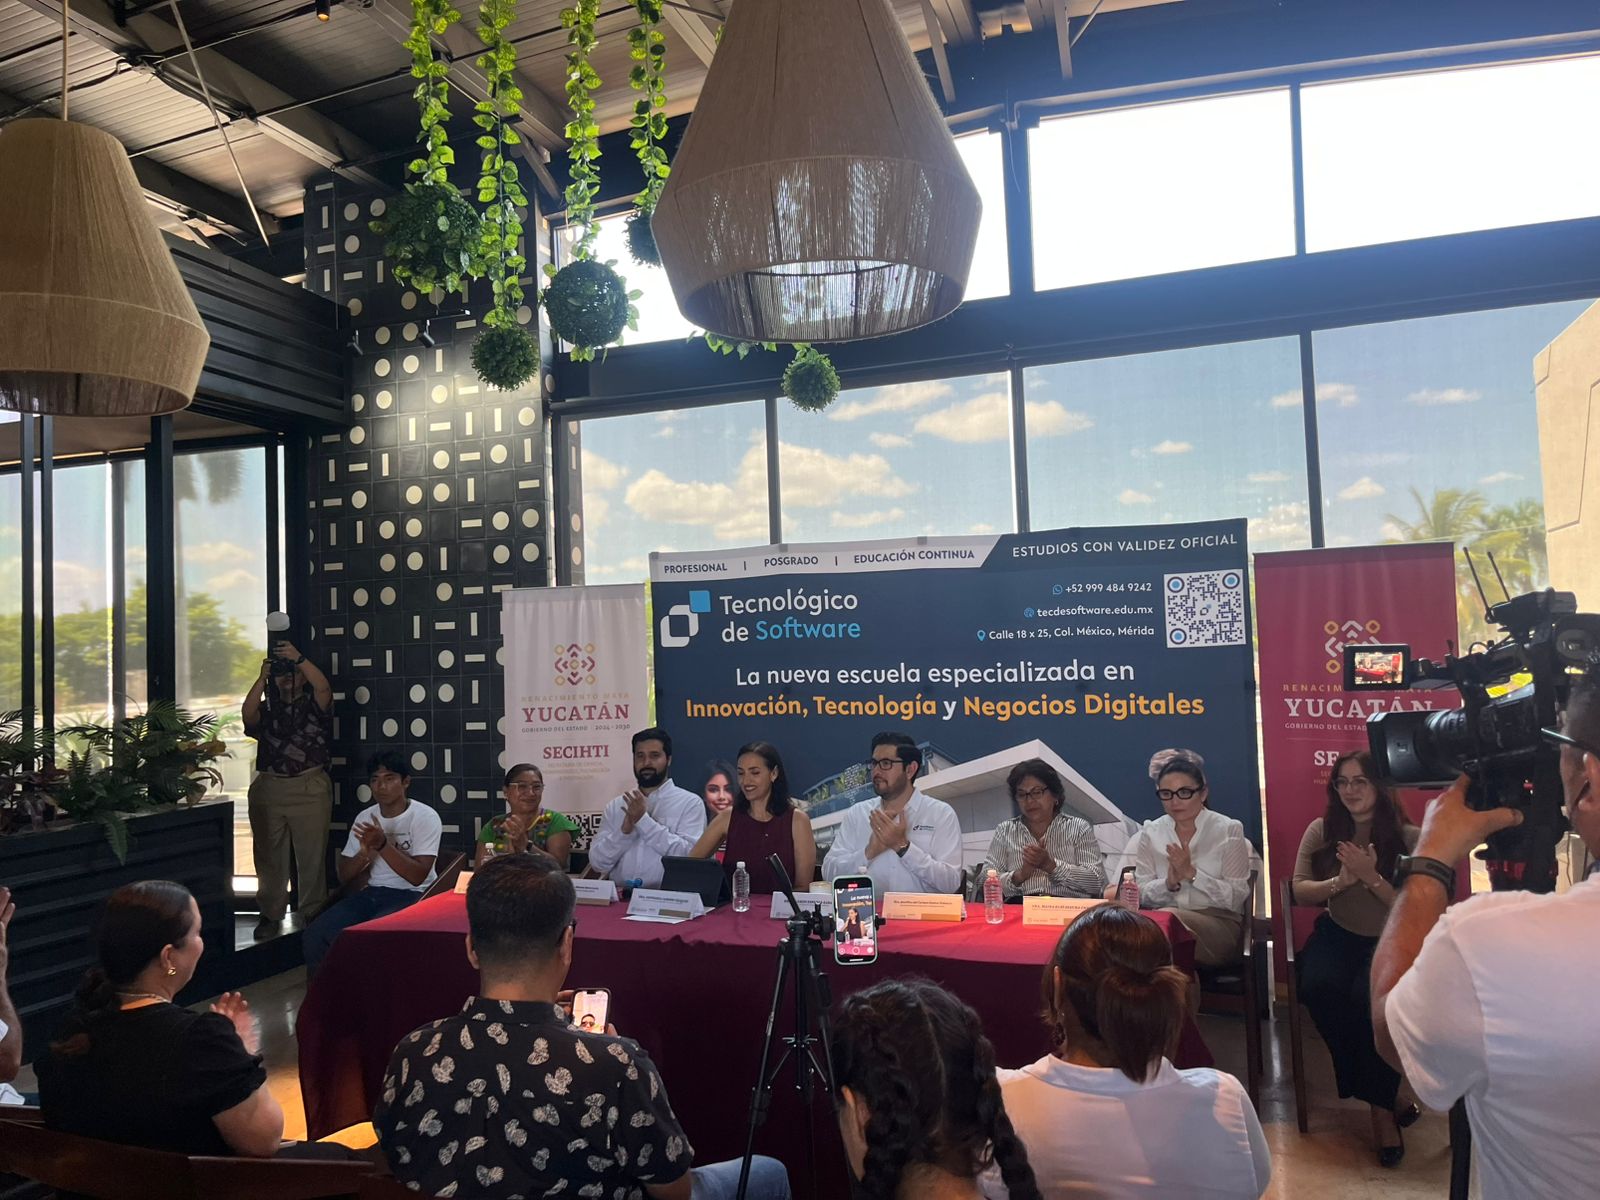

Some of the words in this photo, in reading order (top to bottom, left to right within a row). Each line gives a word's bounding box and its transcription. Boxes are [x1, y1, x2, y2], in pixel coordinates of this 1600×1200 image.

[1012, 542, 1078, 557] ESTUDIOS
[1083, 541, 1113, 552] CON
[1117, 538, 1176, 551] VALIDEZ
[1180, 533, 1237, 549] OFICIAL
[664, 563, 727, 574] PROFESIONAL
[764, 556, 819, 567] POSGRADO
[854, 548, 916, 564] EDUCACIÓN
[918, 549, 975, 560] CONTINUA
[1065, 584, 1083, 593] +52
[1085, 584, 1103, 592] 999
[1106, 583, 1125, 592] 484
[1127, 583, 1152, 592] 9242
[719, 588, 858, 615] Tecnológico
[1037, 605, 1153, 617] tecdesoftware.edu.mx
[721, 621, 749, 642] de
[756, 617, 861, 640] Software
[989, 630, 1014, 640] Calle
[1016, 630, 1027, 639] 18
[1037, 629, 1052, 639] 25,
[1054, 628, 1074, 637] Col.
[1076, 627, 1115, 637] México,
[1118, 626, 1155, 636] Mérida
[736, 668, 760, 686] La
[767, 669, 829, 684] nueva
[837, 663, 920, 683] escuela
[928, 659, 1095, 687] especializada
[1104, 664, 1135, 681] en
[521, 702, 629, 722] YUCATÁN
[686, 694, 808, 718] Innovación,
[813, 693, 937, 720] Tecnología
[942, 701, 957, 720] y
[963, 694, 1077, 721] Negocios
[1084, 692, 1205, 720] Digitales
[1284, 696, 1432, 718] YUCATÁN
[1285, 722, 1325, 730] GOBIERNO
[543, 745, 609, 759] SECIHTI
